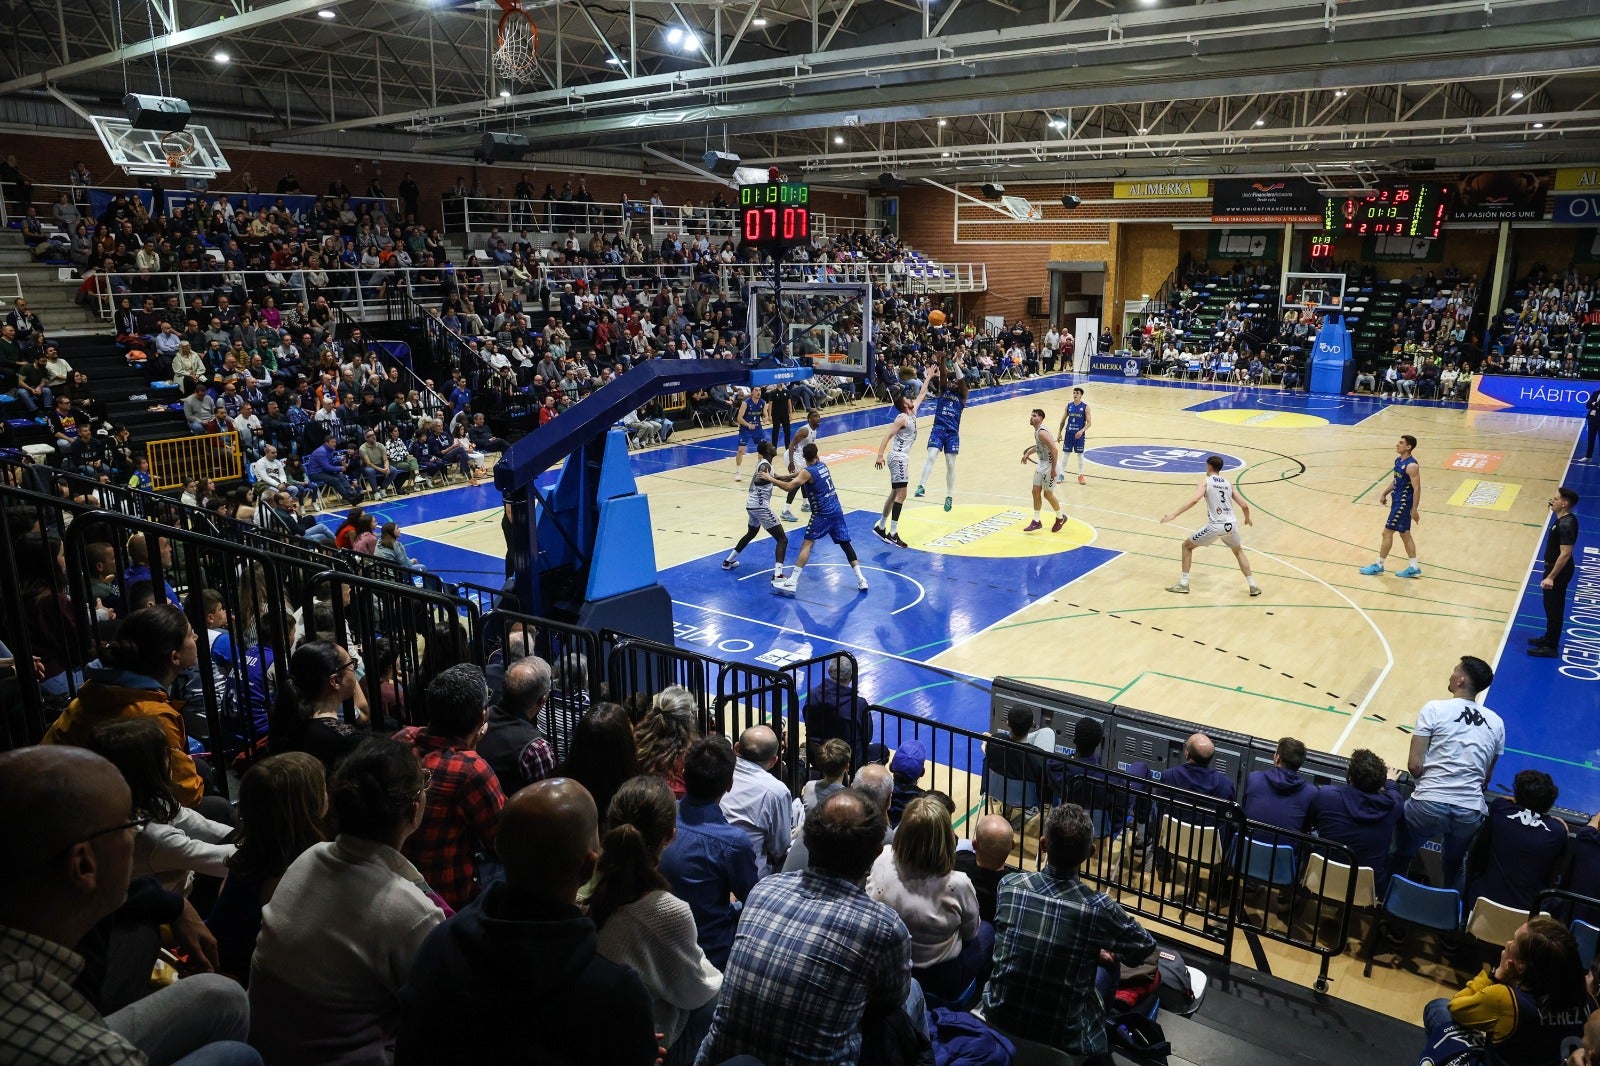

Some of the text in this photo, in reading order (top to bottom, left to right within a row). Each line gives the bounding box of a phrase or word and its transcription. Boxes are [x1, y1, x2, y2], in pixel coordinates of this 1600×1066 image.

[742, 186, 777, 204] 01:13
[781, 186, 808, 203] 01:13
[1129, 182, 1192, 196] ALIMERKA
[1395, 190, 1409, 201] 26
[1367, 207, 1397, 218] 01:13
[1467, 210, 1498, 218] PASIÓN
[746, 208, 776, 240] 07
[783, 208, 807, 239] 07
[1360, 223, 1367, 232] 2
[1396, 223, 1403, 232] 3
[1312, 245, 1329, 256] 07
[1091, 363, 1123, 371] ALIMERKA
[1520, 385, 1591, 404] HÁBITO
[1219, 490, 1227, 504] 3
